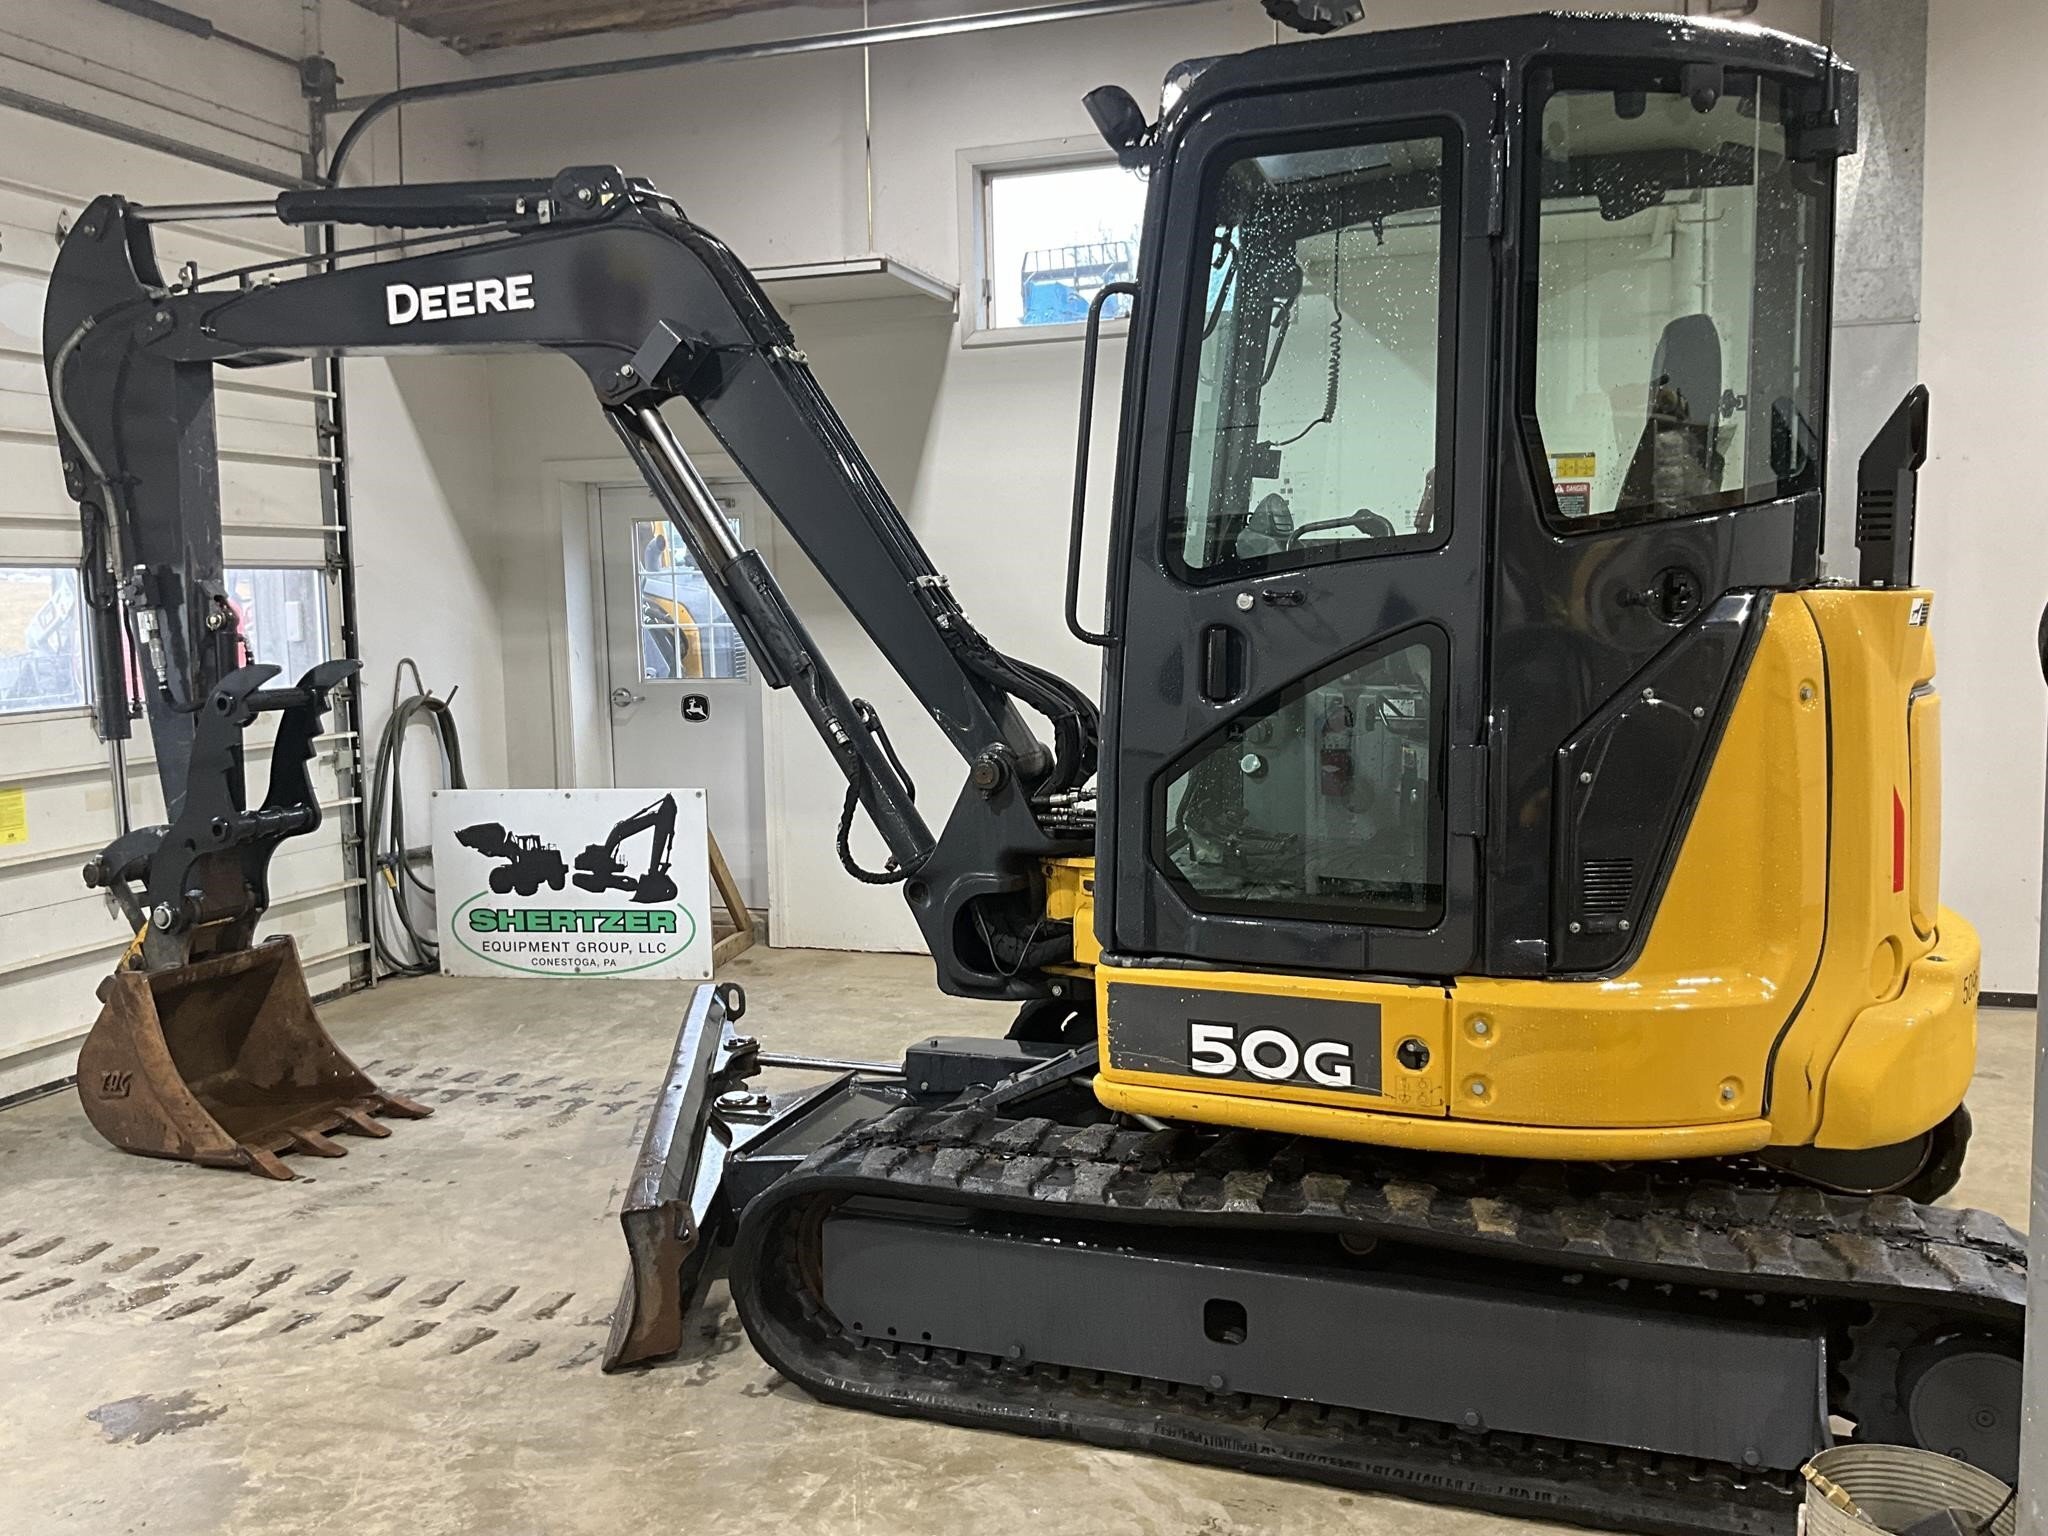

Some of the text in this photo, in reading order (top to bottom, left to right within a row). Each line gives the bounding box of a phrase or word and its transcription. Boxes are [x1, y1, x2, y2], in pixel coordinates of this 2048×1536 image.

[386, 274, 535, 325] DEERE
[469, 908, 677, 934] SHERTZER
[482, 940, 667, 955] EQUIPMENT GROUP, LLC
[531, 957, 617, 968] CONESTOGA, PA
[1190, 1023, 1353, 1088] 50G
